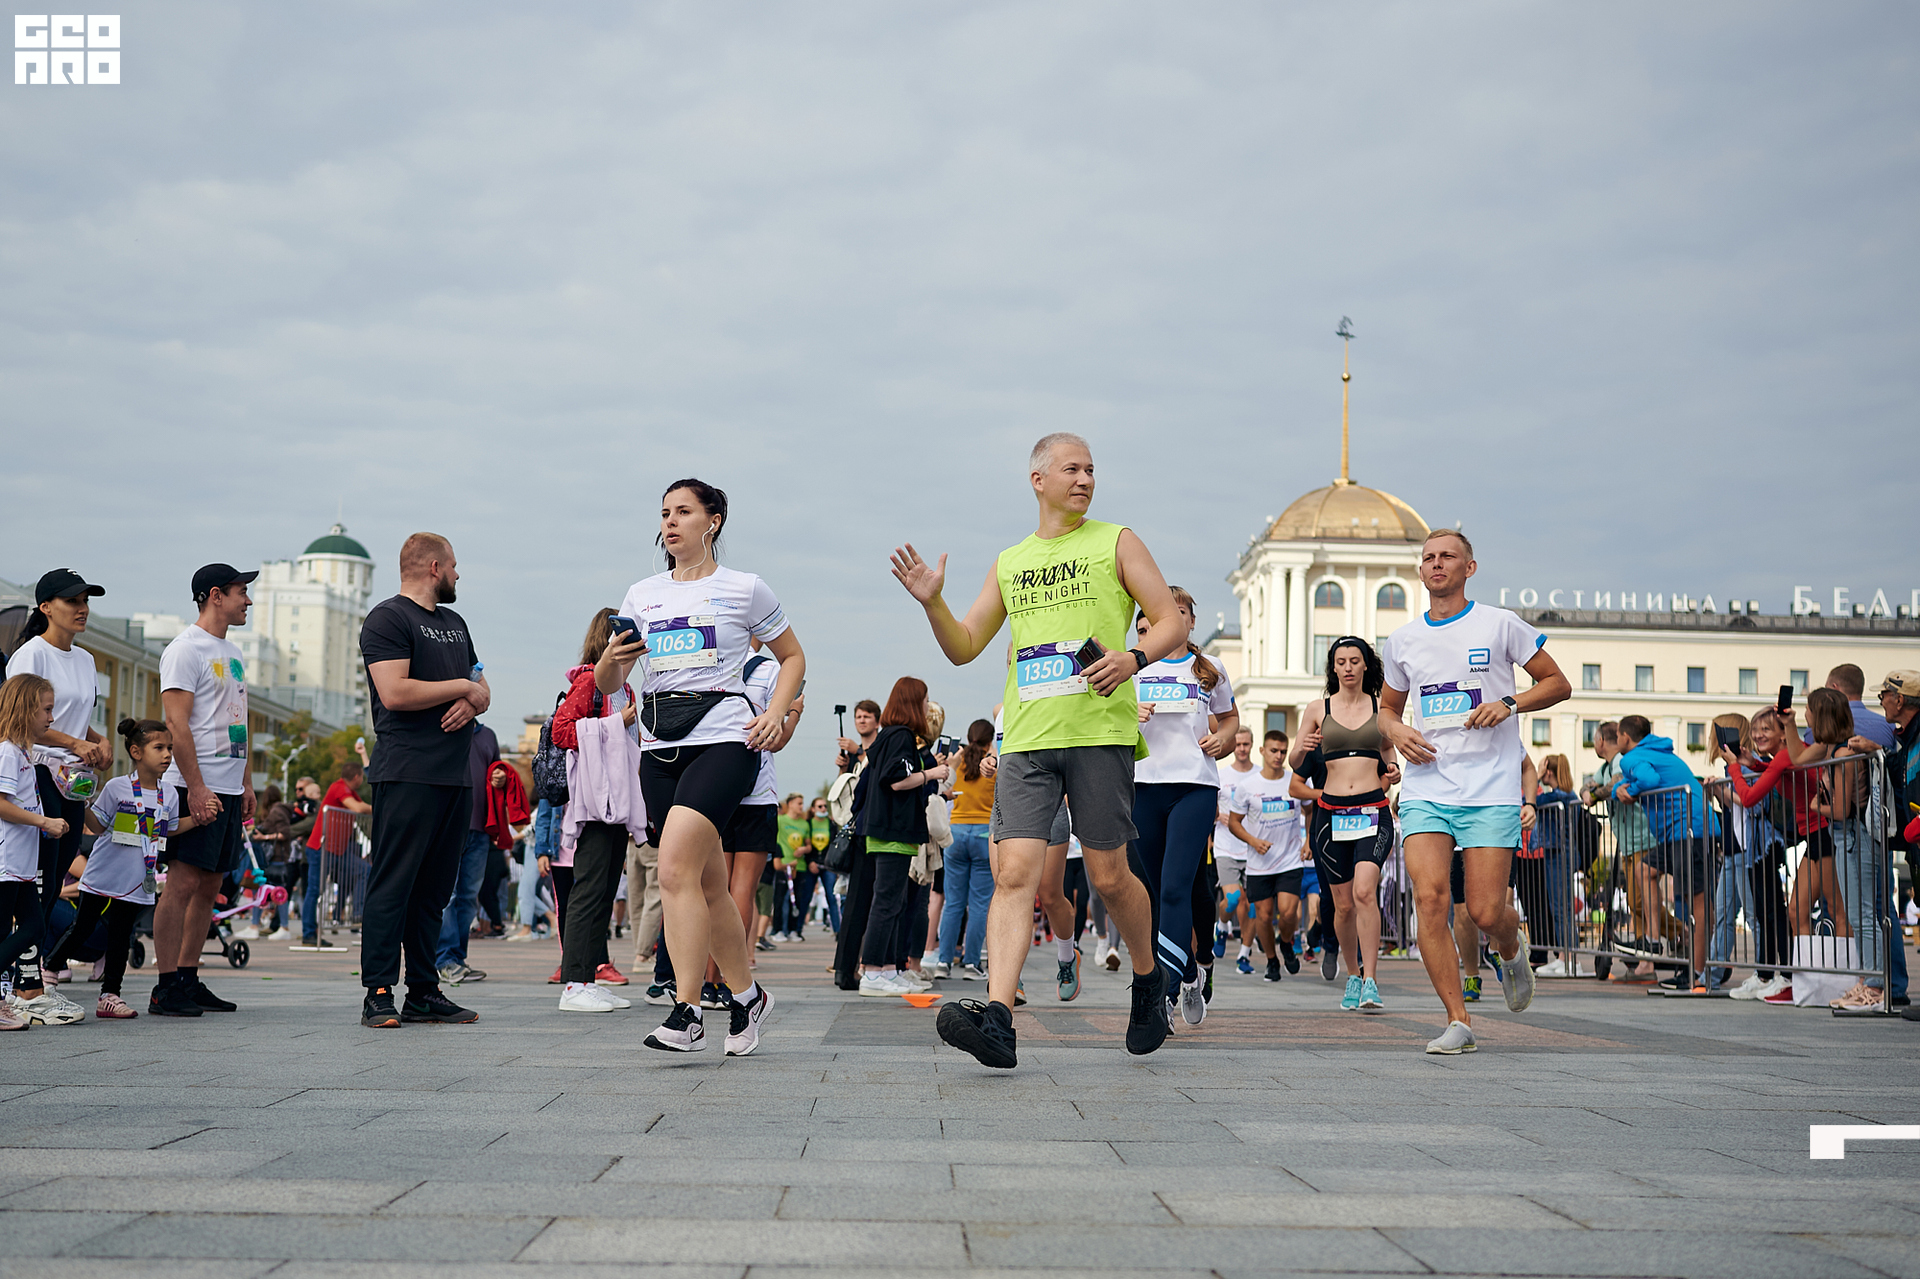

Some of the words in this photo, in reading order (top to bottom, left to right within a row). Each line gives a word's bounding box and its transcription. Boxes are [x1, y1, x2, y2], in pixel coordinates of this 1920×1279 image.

[1020, 559, 1077, 590] RUN
[1011, 592, 1038, 607] THE
[1044, 582, 1090, 601] NIGHT
[1500, 588, 1717, 613] ГОСТИНИЦА
[1066, 601, 1097, 609] RULES
[656, 632, 697, 654] 1063
[1024, 659, 1065, 682] 1350
[1148, 686, 1182, 699] 1326
[1428, 695, 1465, 714] 1327
[1266, 803, 1285, 812] 1170
[1338, 818, 1362, 829] 1121
